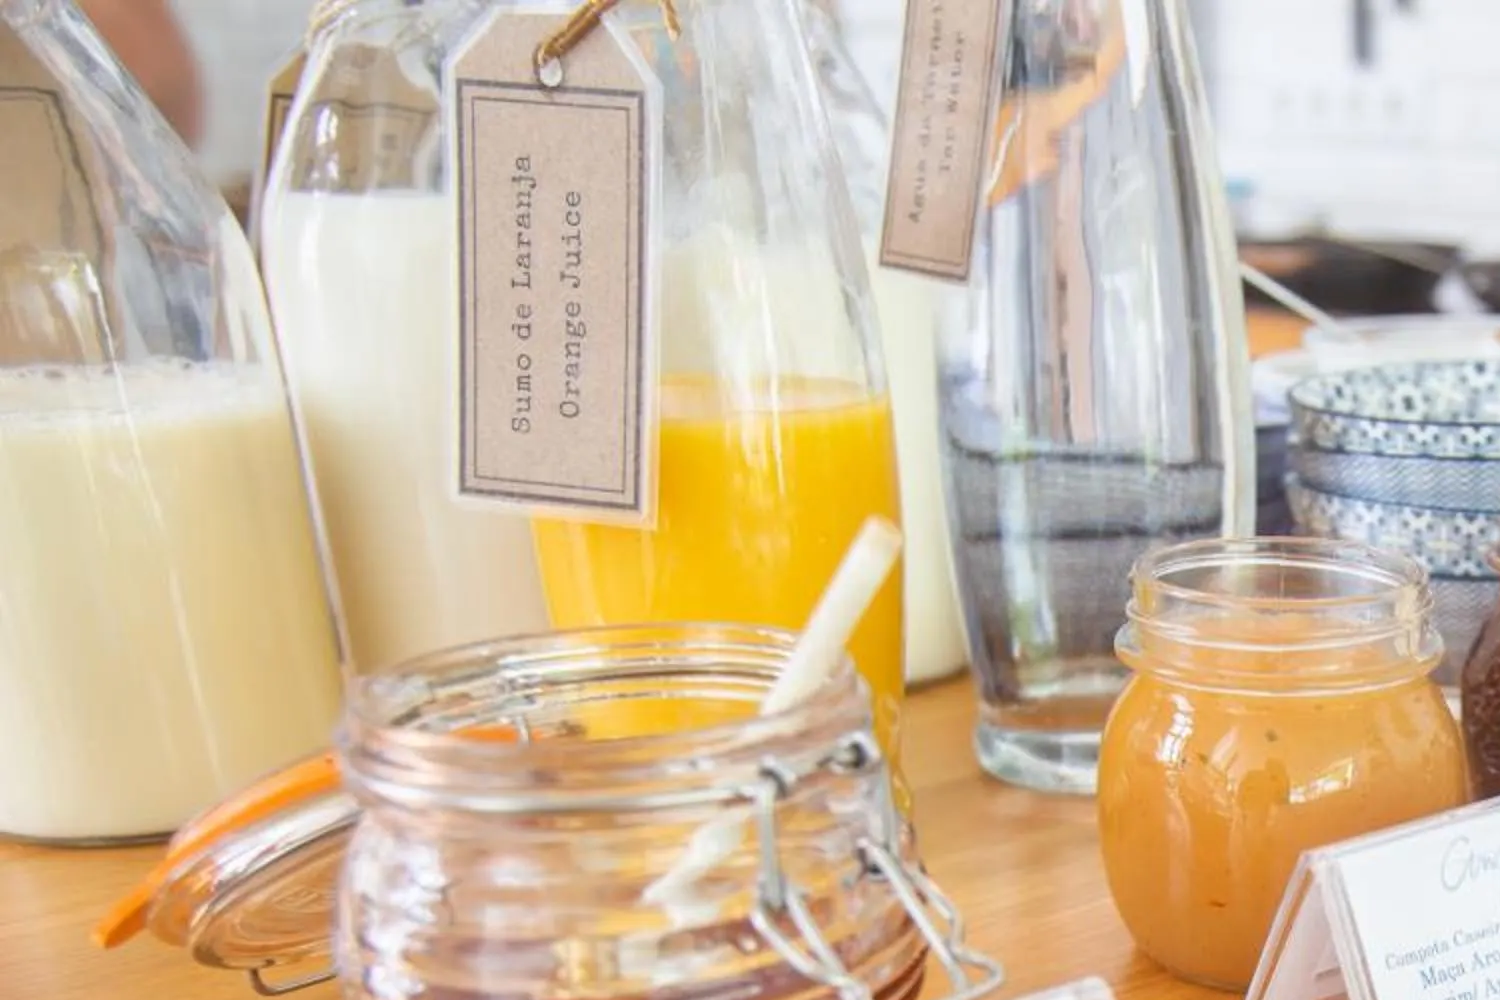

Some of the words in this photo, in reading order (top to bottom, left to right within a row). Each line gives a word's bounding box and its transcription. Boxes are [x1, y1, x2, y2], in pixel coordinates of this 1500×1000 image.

[511, 153, 537, 290] Laranja
[559, 190, 583, 289] Juice
[511, 303, 533, 341] de
[559, 304, 587, 420] Orange
[511, 353, 533, 435] Sumo
